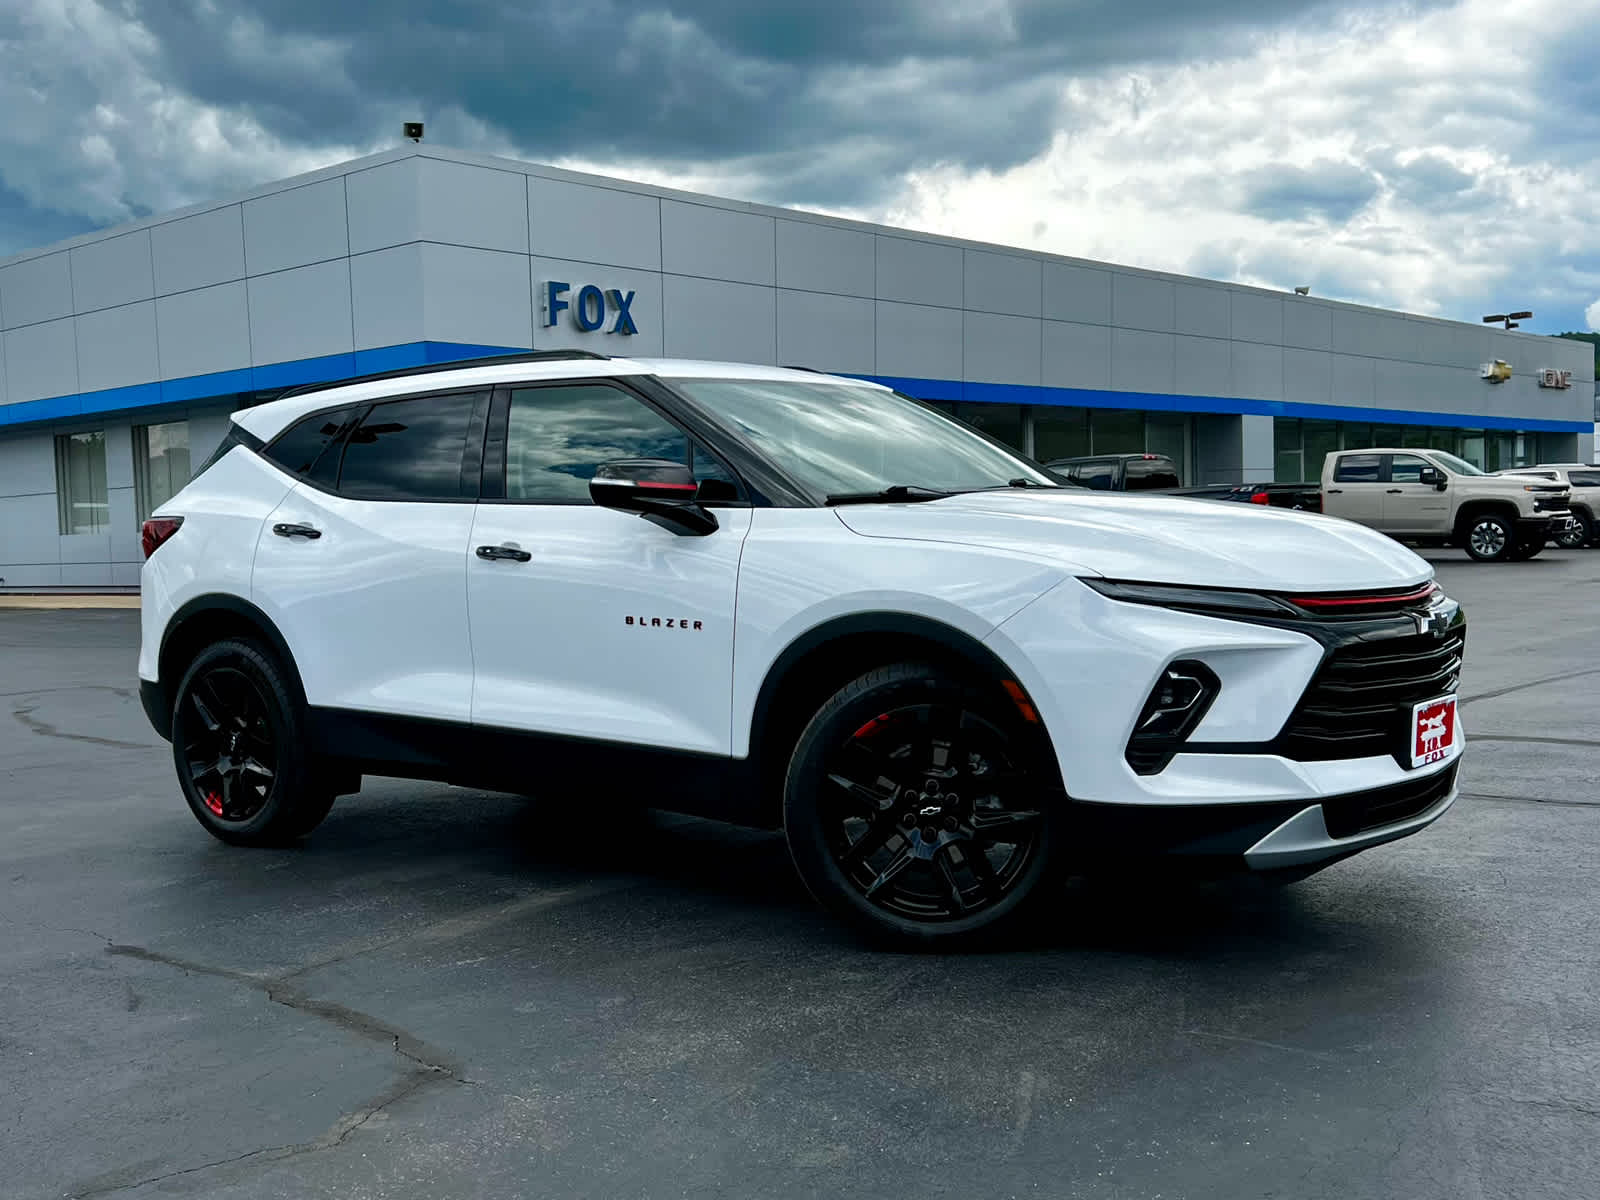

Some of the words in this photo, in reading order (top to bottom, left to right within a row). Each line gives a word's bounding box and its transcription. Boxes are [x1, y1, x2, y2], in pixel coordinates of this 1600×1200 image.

[545, 281, 639, 335] FOX
[625, 616, 703, 630] BLAZER
[1425, 750, 1445, 764] FOX
